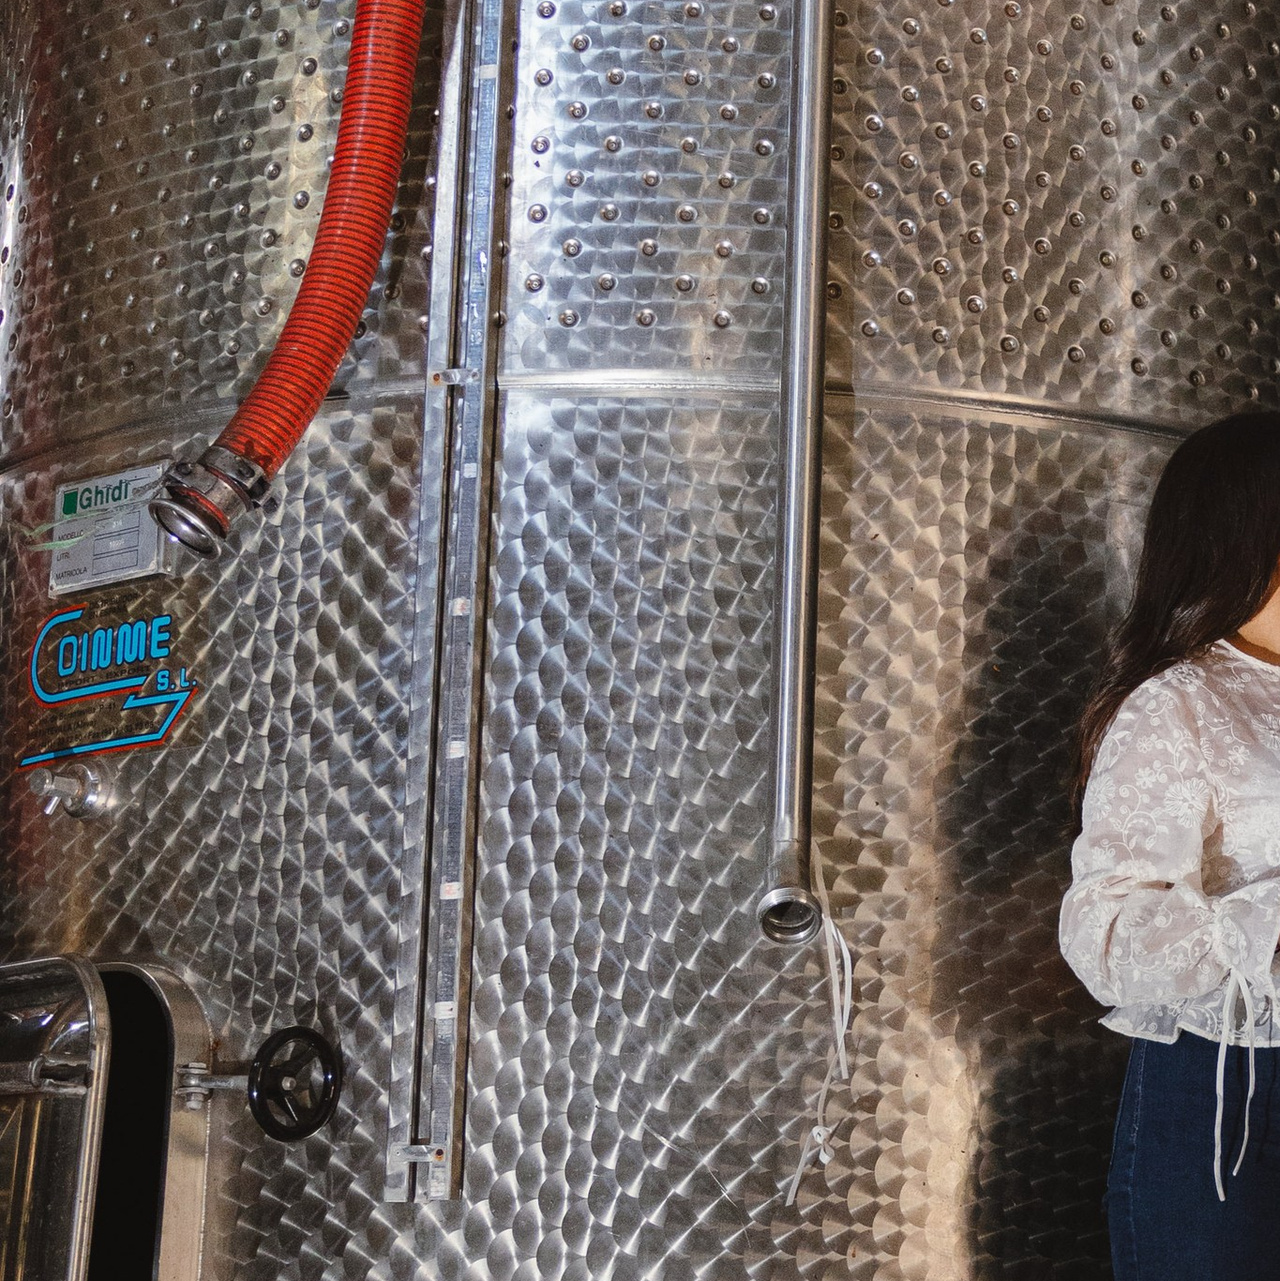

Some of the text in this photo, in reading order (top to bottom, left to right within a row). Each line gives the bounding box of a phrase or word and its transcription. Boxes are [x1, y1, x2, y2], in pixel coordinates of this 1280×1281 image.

[79, 479, 129, 509] Ghidi
[56, 567, 87, 580] MATRICOLA
[30, 603, 172, 708] COINME
